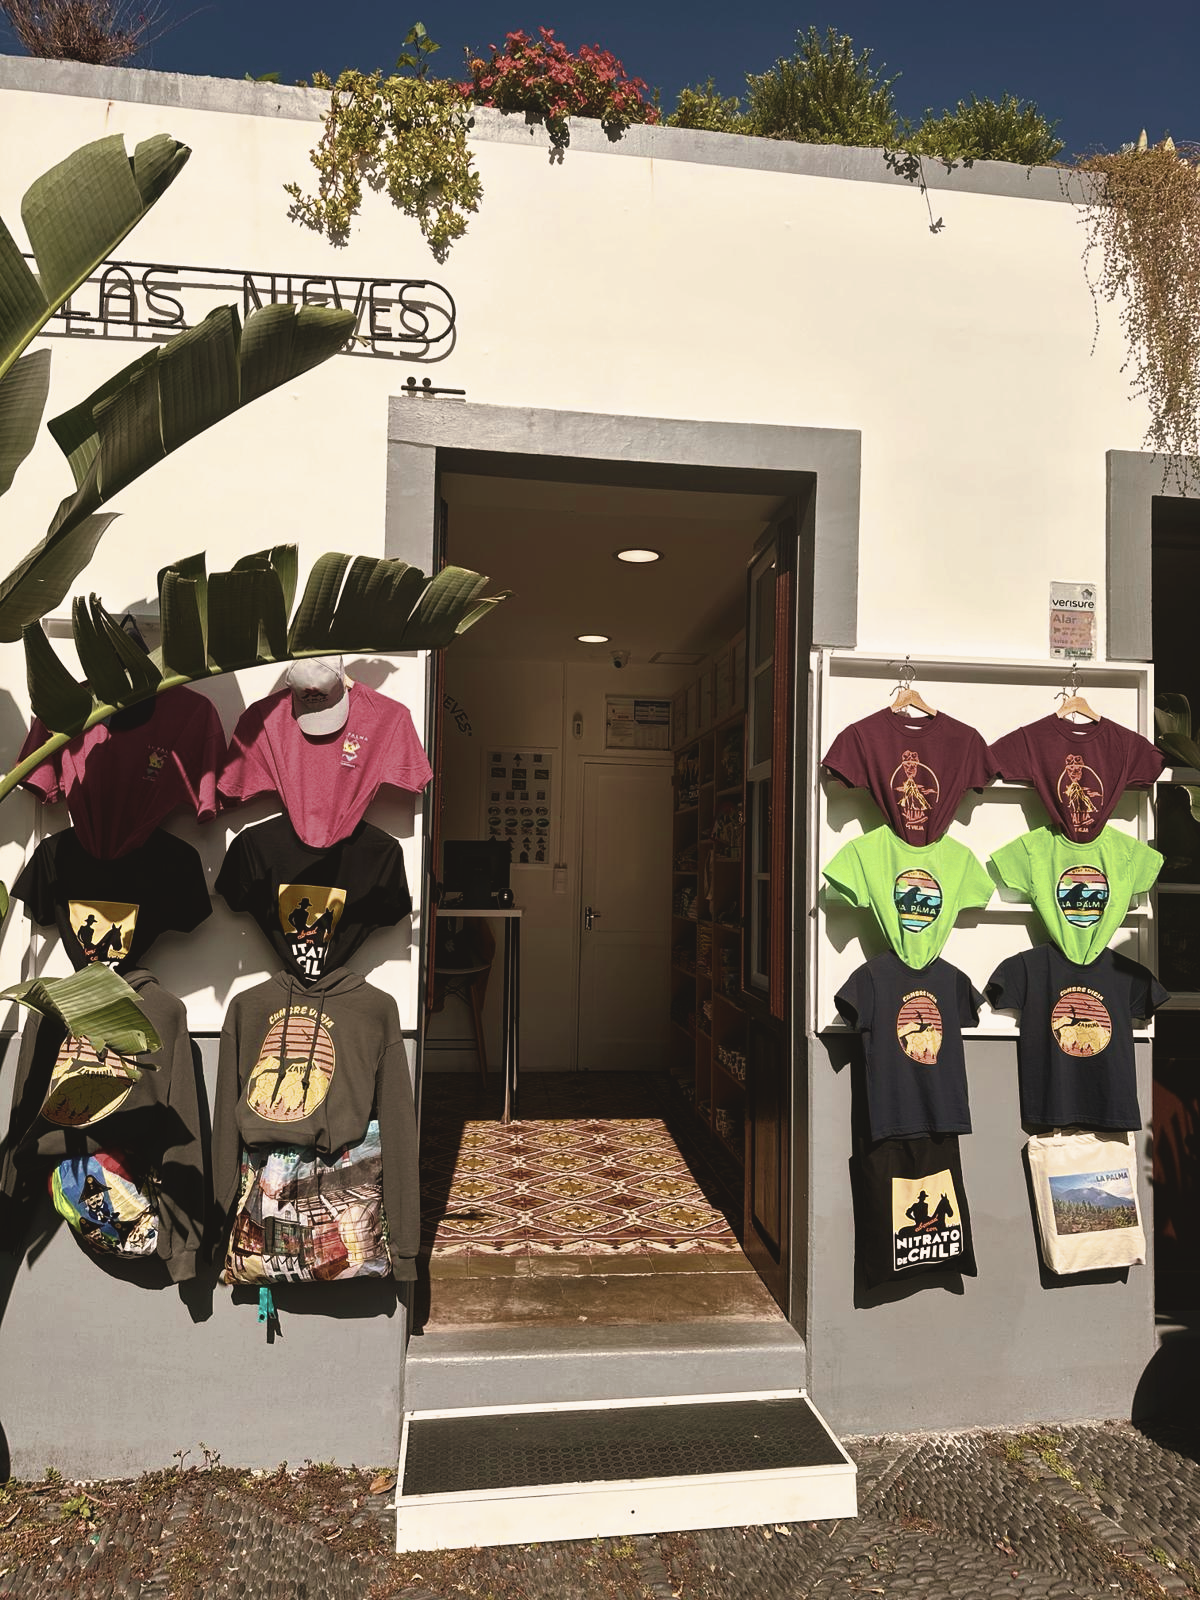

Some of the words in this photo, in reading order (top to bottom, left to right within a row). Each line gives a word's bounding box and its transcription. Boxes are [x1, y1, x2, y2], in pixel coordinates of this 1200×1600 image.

[1052, 599, 1095, 609] verisure
[1106, 1171, 1128, 1181] PALMA
[896, 1229, 961, 1250] NITRATO
[908, 1242, 960, 1262] CHILE
